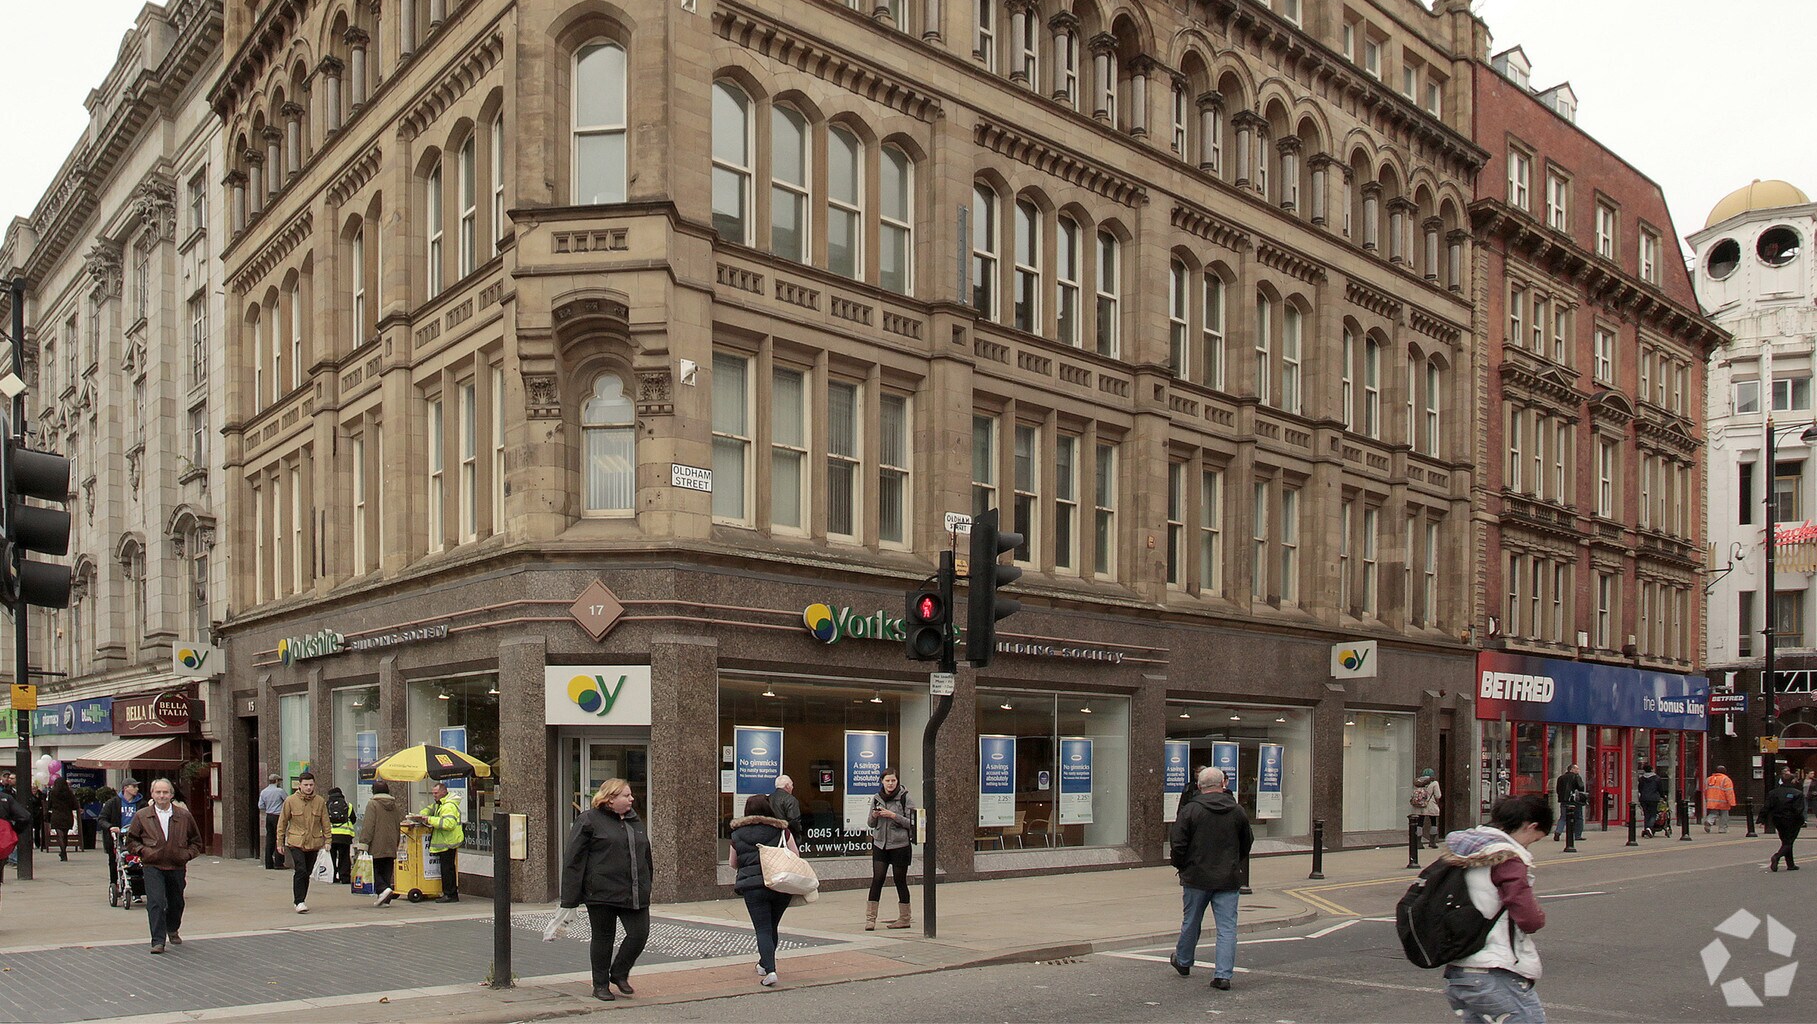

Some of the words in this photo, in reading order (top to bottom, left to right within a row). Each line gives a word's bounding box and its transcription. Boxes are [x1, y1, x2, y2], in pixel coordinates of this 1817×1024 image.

[673, 465, 710, 480] OLDHAM
[675, 477, 709, 489] STREET
[946, 515, 969, 523] OLDHAM
[589, 605, 604, 615] 17
[827, 604, 906, 644] Yorks
[994, 641, 1055, 657] ILDING
[1062, 647, 1124, 664] SOCIETY
[1480, 670, 1555, 703] BETFRED
[159, 701, 188, 710] BELLA
[248, 700, 255, 712] 15
[1643, 695, 1656, 711] the
[1658, 697, 1684, 714] bonus
[1686, 699, 1705, 718] king
[125, 705, 147, 722] BELLA
[159, 708, 189, 717] ITALIA
[740, 758, 749, 766] No
[750, 759, 778, 767] gimmicks
[859, 762, 880, 770] savings
[853, 775, 880, 783] absolutely
[807, 828, 832, 838] 0845
[834, 828, 840, 838] 1
